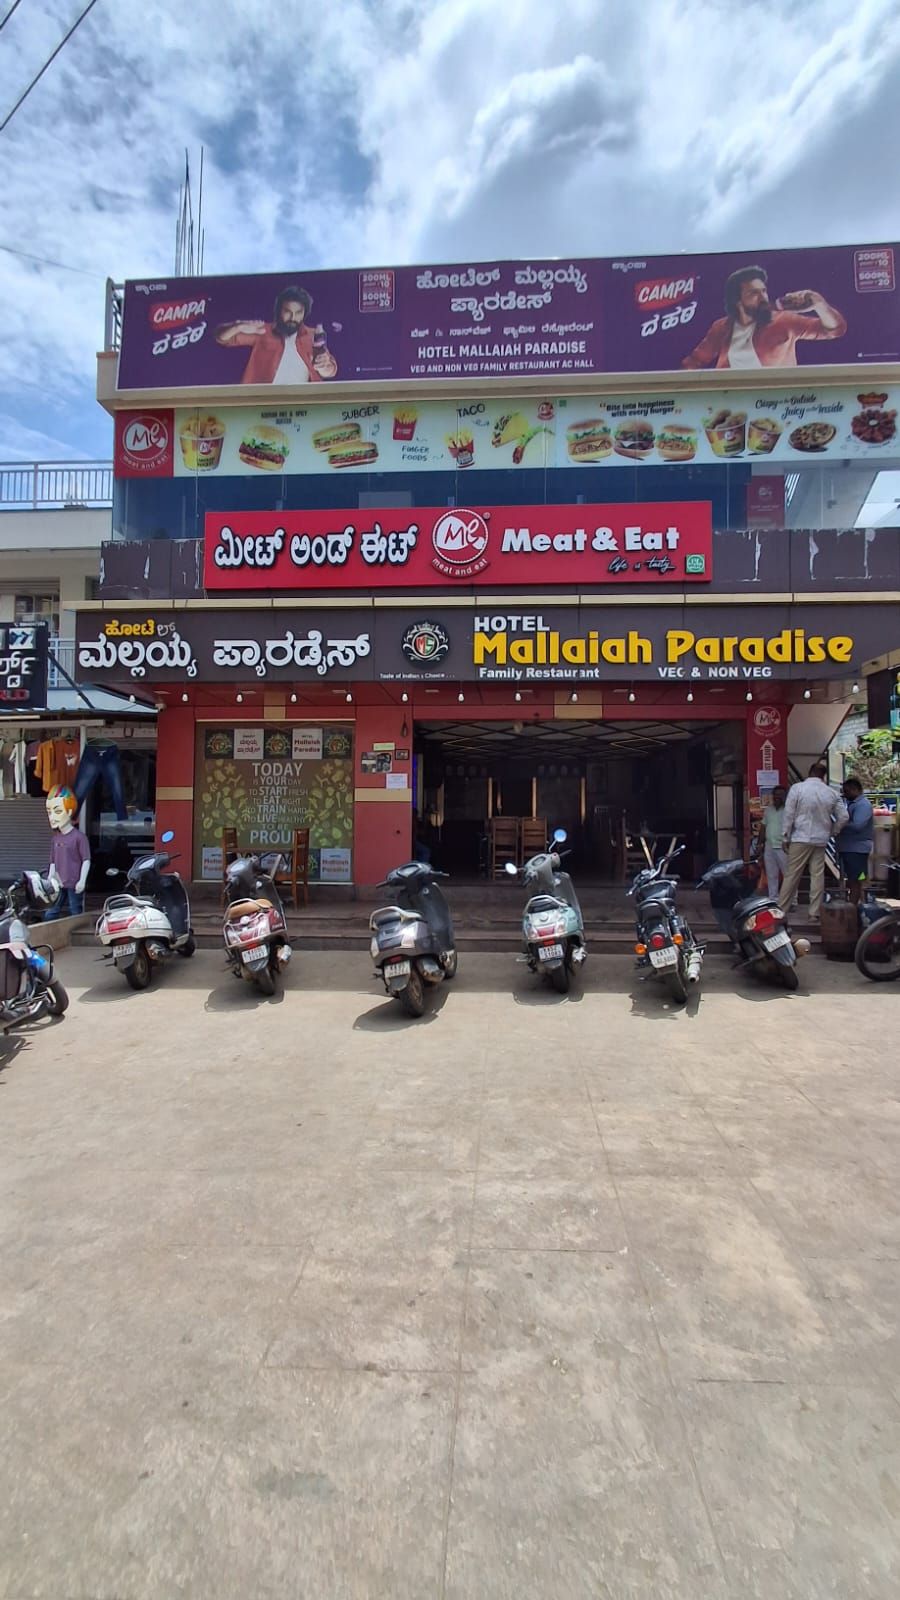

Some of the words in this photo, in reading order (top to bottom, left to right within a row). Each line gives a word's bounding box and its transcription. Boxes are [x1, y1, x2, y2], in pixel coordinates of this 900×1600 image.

[416, 267, 500, 289] ಹೋಟೆಲ್
[514, 264, 588, 293] ಮಲ್ಲಯ್ಯ
[638, 277, 694, 303] CAMPA
[153, 299, 206, 324] CAMPA
[418, 346, 456, 359] HOTEL
[459, 343, 521, 357] MALLAIAH
[524, 341, 586, 355] PARADISE
[410, 364, 426, 374] VEG
[427, 364, 444, 373] AND
[445, 363, 462, 373] NON
[464, 362, 479, 372] VEG
[480, 361, 507, 372] FAMILY
[509, 359, 560, 371] RESTAURANT
[562, 359, 573, 369] AC
[574, 358, 595, 369] HALL
[341, 406, 380, 421] SUBGER
[456, 403, 486, 418] TACO
[214, 526, 284, 567] ಮೀಟ್
[291, 526, 355, 565] ಅಂಡ್
[360, 523, 419, 564] ಈಟ್
[502, 528, 588, 552] Meat
[592, 527, 619, 551] &
[625, 526, 680, 551] Eat
[432, 558, 453, 574] meat
[455, 566, 473, 576] and
[474, 558, 488, 570] eat
[474, 616, 550, 632] HOTEL
[78, 633, 198, 677] ಮಲ್ಲಯ್ಯ
[212, 629, 371, 676] ಪ್ಯಾರಡೈಸ್
[473, 631, 652, 665] Mallaiah
[666, 629, 854, 664] Paradise
[479, 667, 523, 680] Family
[691, 667, 701, 678] &
[708, 667, 738, 677] NON
[742, 667, 773, 677] VEG
[252, 762, 303, 777] TODAY
[260, 776, 287, 786] YOUR
[259, 786, 288, 797] START
[263, 796, 280, 805] EAT
[257, 804, 286, 814] TRAIN
[257, 813, 277, 823] LIVE
[250, 830, 294, 844] PROU
